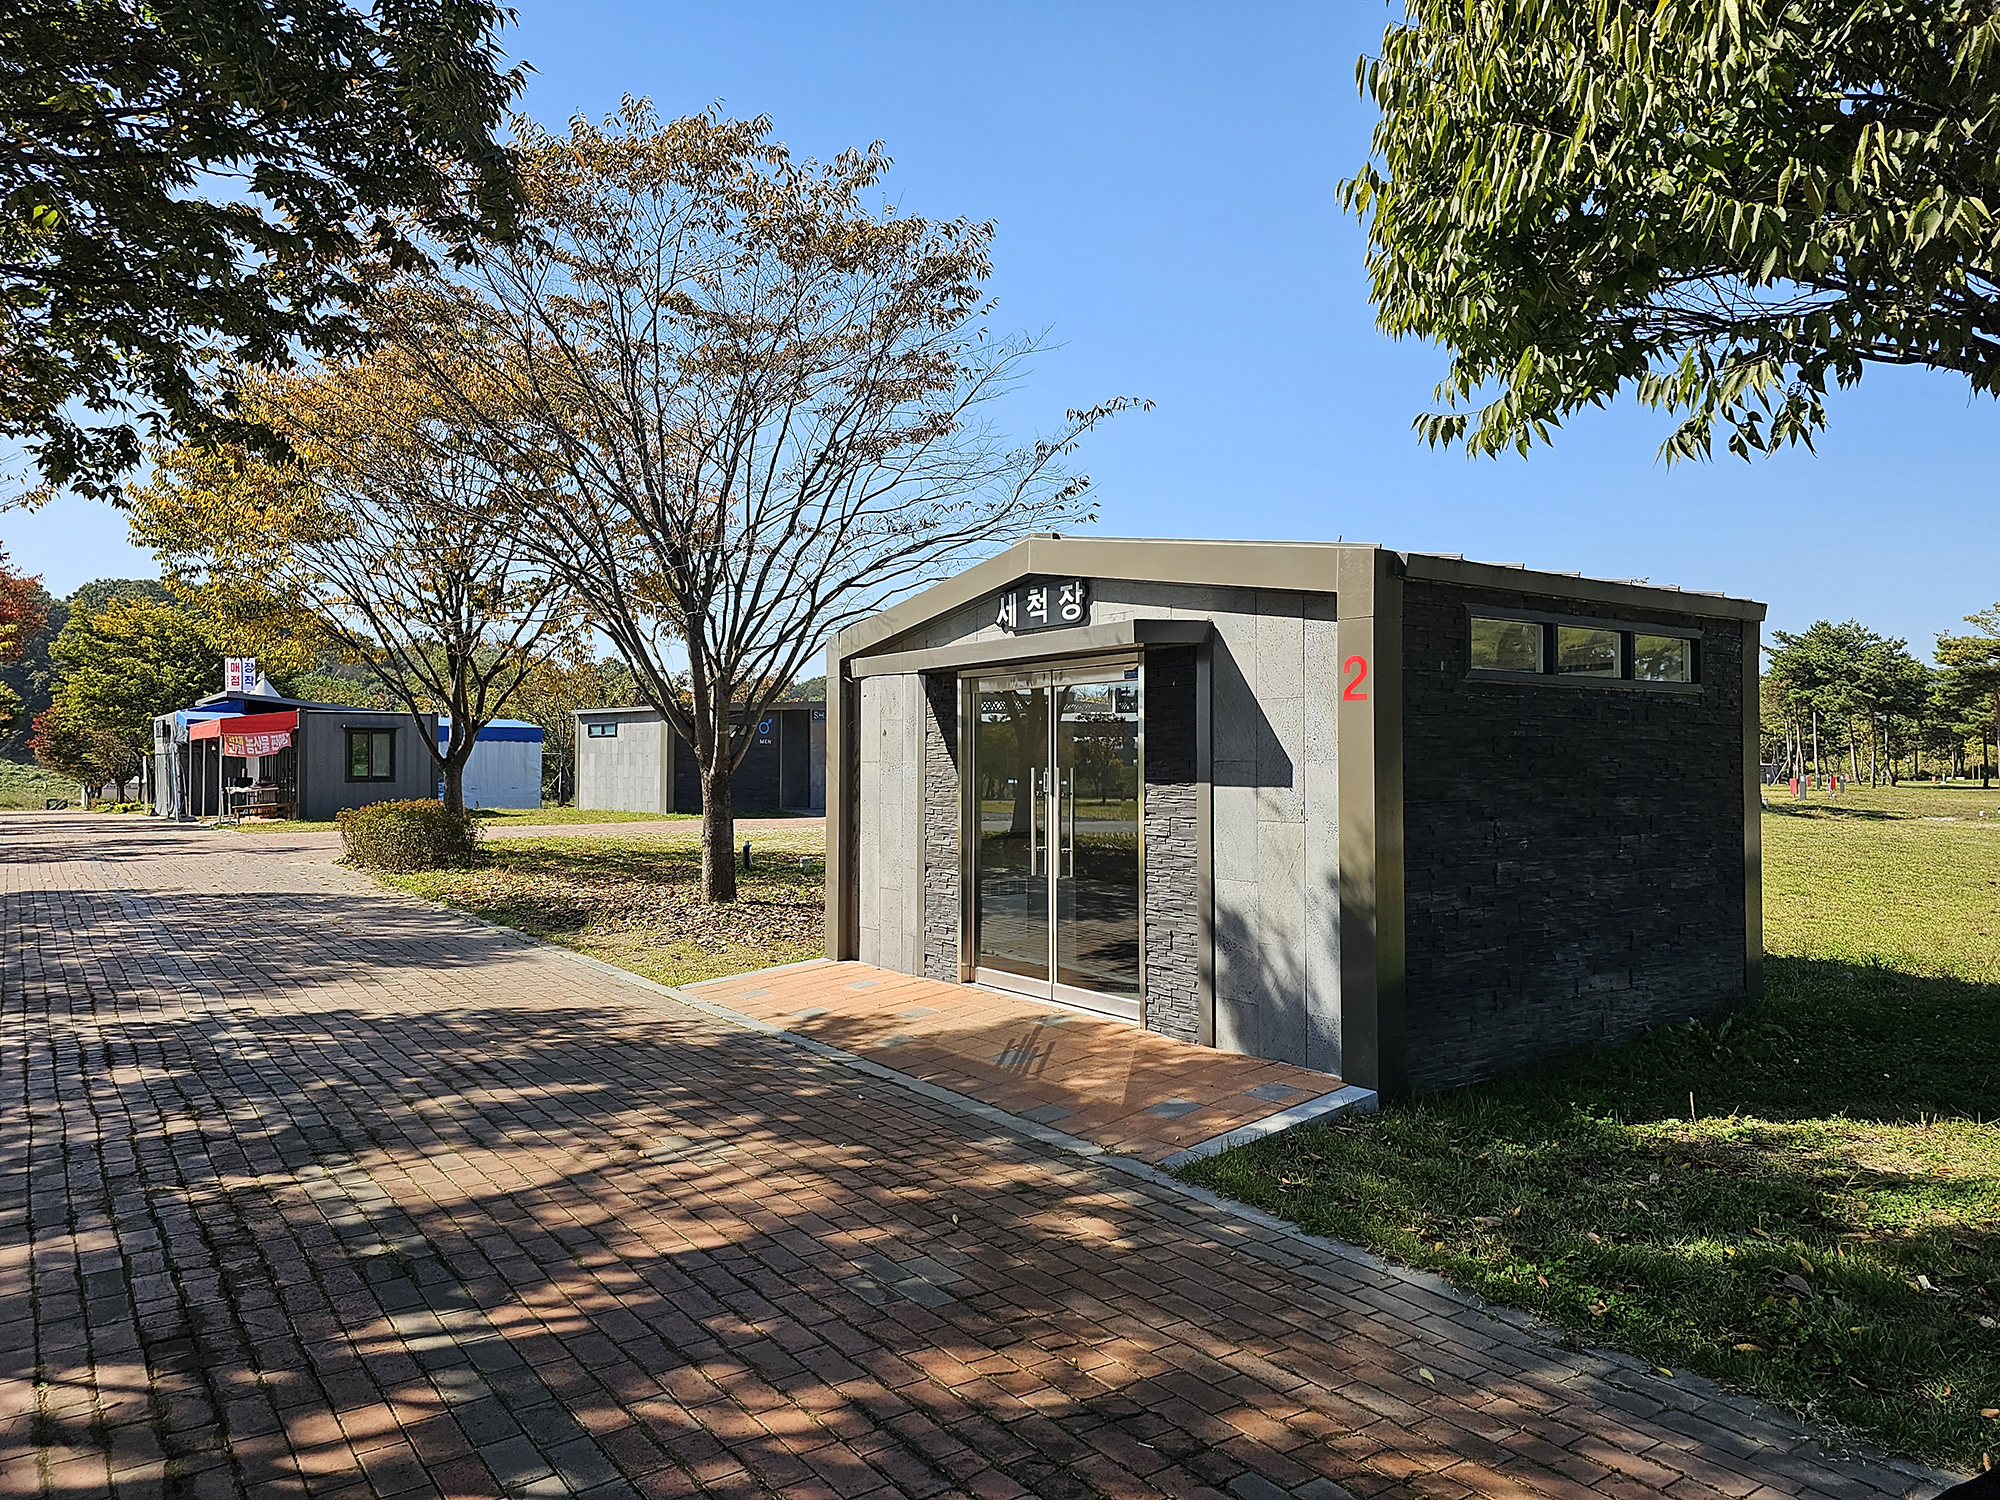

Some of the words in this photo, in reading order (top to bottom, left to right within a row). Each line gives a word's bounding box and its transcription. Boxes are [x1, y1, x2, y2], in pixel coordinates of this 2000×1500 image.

[996, 581, 1083, 628] 세척장
[230, 662, 240, 686] 매점
[244, 662, 254, 686] 장작
[1342, 654, 1368, 701] 2
[245, 735, 270, 755] 농산물
